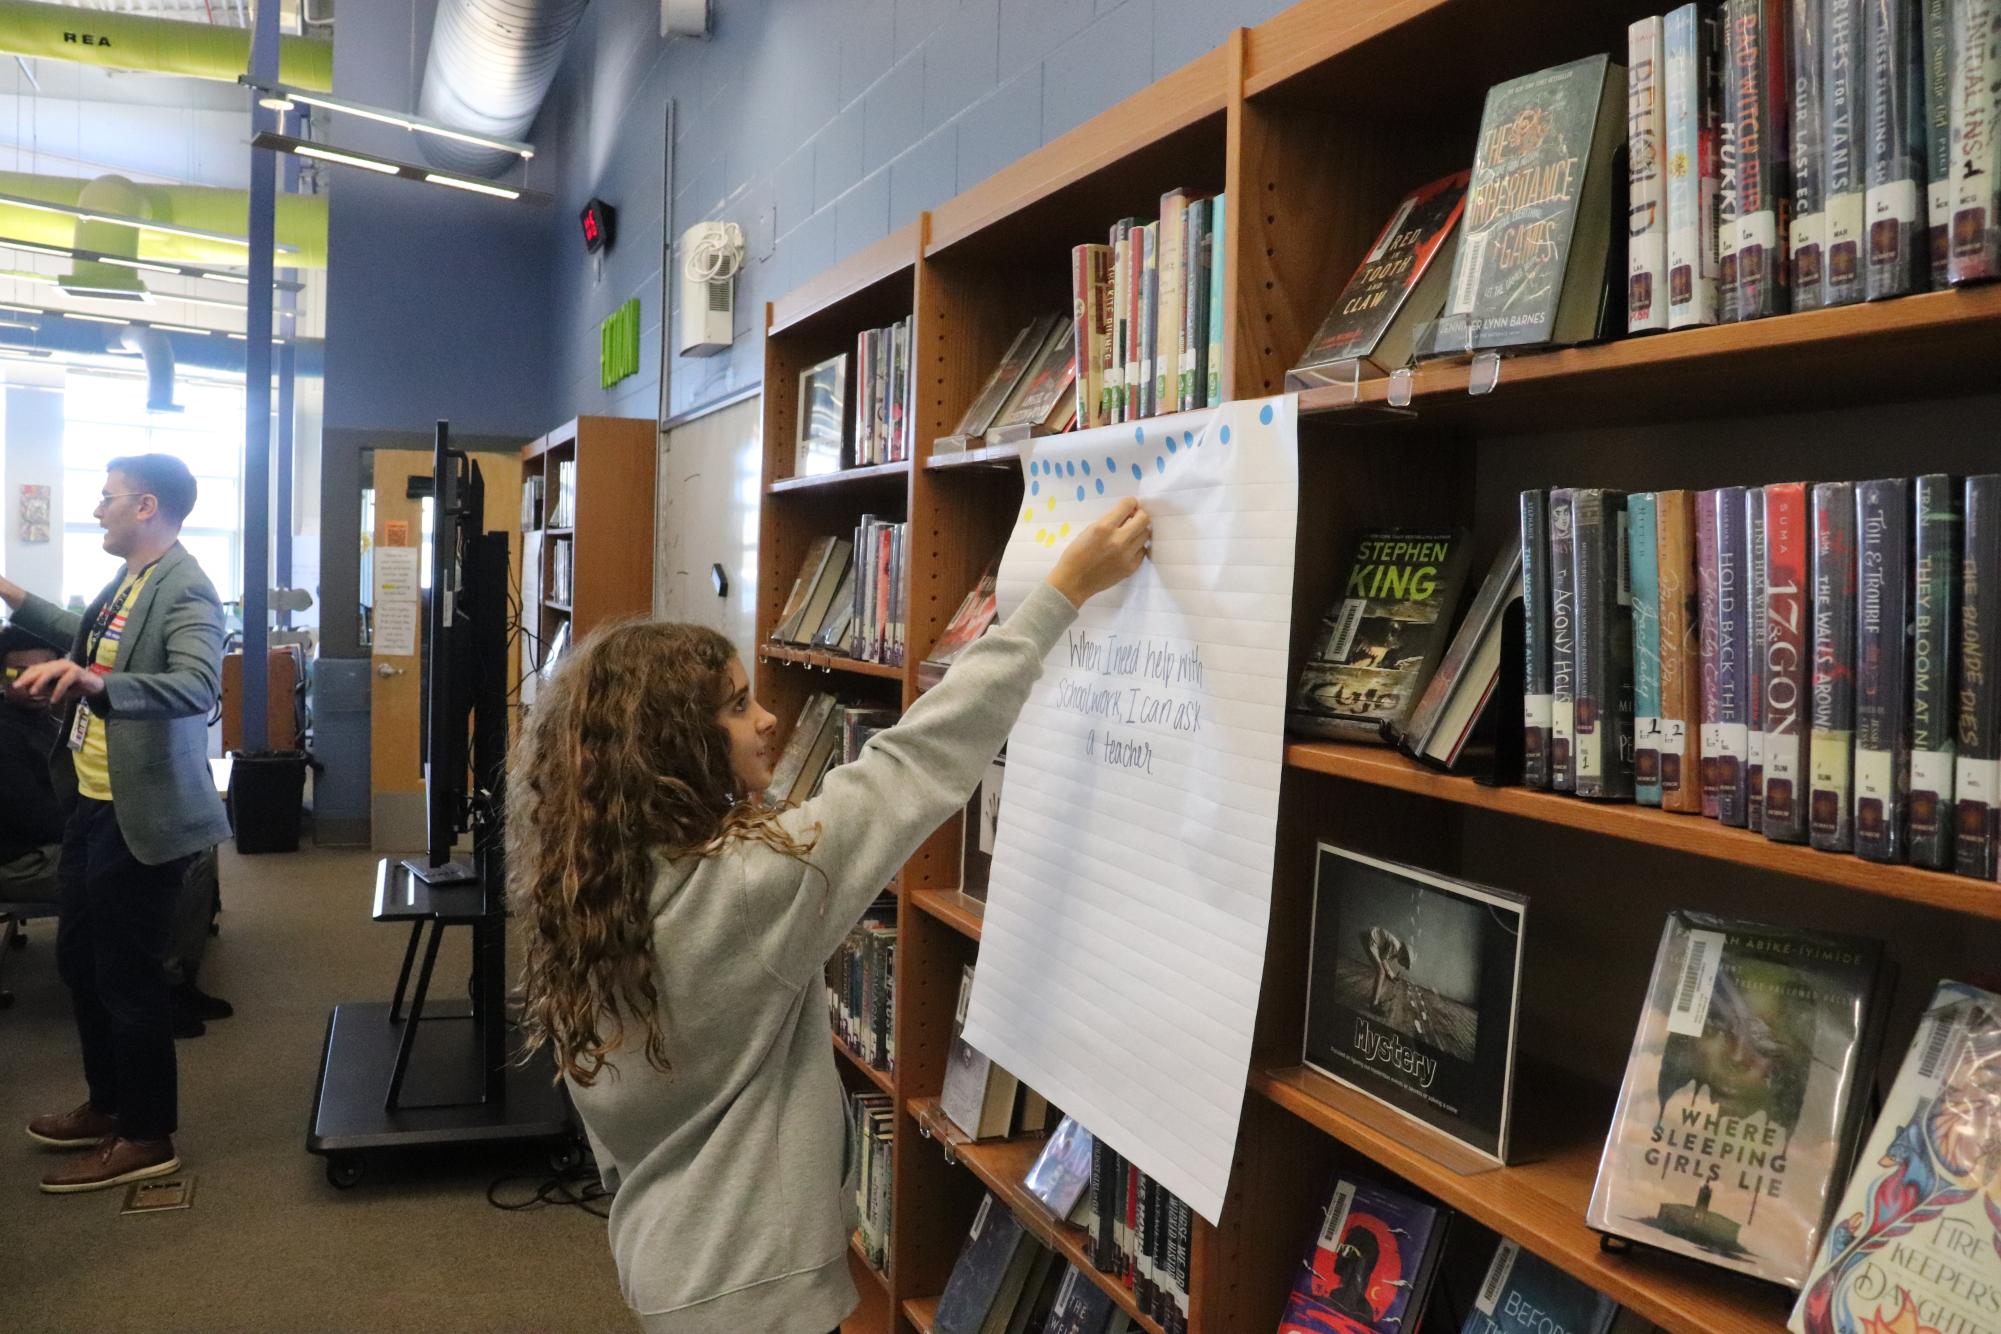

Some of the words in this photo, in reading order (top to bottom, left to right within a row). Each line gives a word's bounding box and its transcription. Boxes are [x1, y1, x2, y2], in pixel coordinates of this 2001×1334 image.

[63, 31, 111, 47] REA
[1735, 13, 1758, 66] BAD
[1737, 74, 1760, 154] WITCH
[1795, 76, 1808, 122] OUR
[1834, 79, 1845, 106] FOR
[1875, 78, 1886, 154] FLEETING
[1485, 123, 1513, 165] THE
[1795, 131, 1808, 179] LAST
[1390, 228, 1423, 251] RED
[1360, 255, 1413, 285] TOOTH
[1343, 290, 1388, 315] CLAW
[1483, 317, 1508, 329] LYNN
[1509, 312, 1546, 327] BARNES
[1921, 486, 1931, 527] TRAN
[1754, 520, 1764, 555] FIND
[1779, 503, 1789, 554] SUMA
[1357, 541, 1449, 562] STEPHEN
[1345, 564, 1437, 601] KING
[1524, 573, 1532, 618] WOODS
[1720, 552, 1734, 613] HOLD
[1754, 560, 1764, 588] HIM
[1818, 575, 1830, 605] THE
[1917, 555, 1931, 608] THEY
[1553, 588, 1573, 654] AGONY
[1755, 592, 1764, 647] WHERE
[1816, 611, 1833, 665] WALLS
[1068, 630, 1102, 673] When
[1102, 634, 1117, 676] I
[1113, 640, 1141, 676] need
[1144, 640, 1175, 688] help
[1177, 643, 1203, 688] with
[1720, 621, 1735, 673] BACK
[1916, 615, 1931, 692] BLOOM
[1962, 606, 1985, 686] BLONDE
[1126, 688, 1141, 724] I
[1140, 696, 1173, 724] can
[1173, 700, 1201, 733] ask
[1721, 681, 1735, 719] THE
[1914, 703, 1929, 723] AT
[1958, 690, 1978, 747] DIES
[1086, 729, 1095, 756] a
[1648, 718, 1662, 734] 1
[1672, 724, 1684, 736] 2
[1582, 756, 1590, 769] 1
[1354, 1016, 1437, 1088] Mystery
[1651, 1125, 1787, 1173] SLEEPING
[1681, 1108, 1777, 1147] WHERE
[1644, 1148, 1721, 1182] GIRLS
[1738, 1170, 1783, 1198] LIE
[1168, 1197, 1179, 1234] WICKED
[1176, 1243, 1188, 1266] WE
[1932, 1216, 1990, 1263] FIRE
[1891, 1242, 2001, 1313] KEEPER'S
[1068, 1295, 1089, 1320] THE
